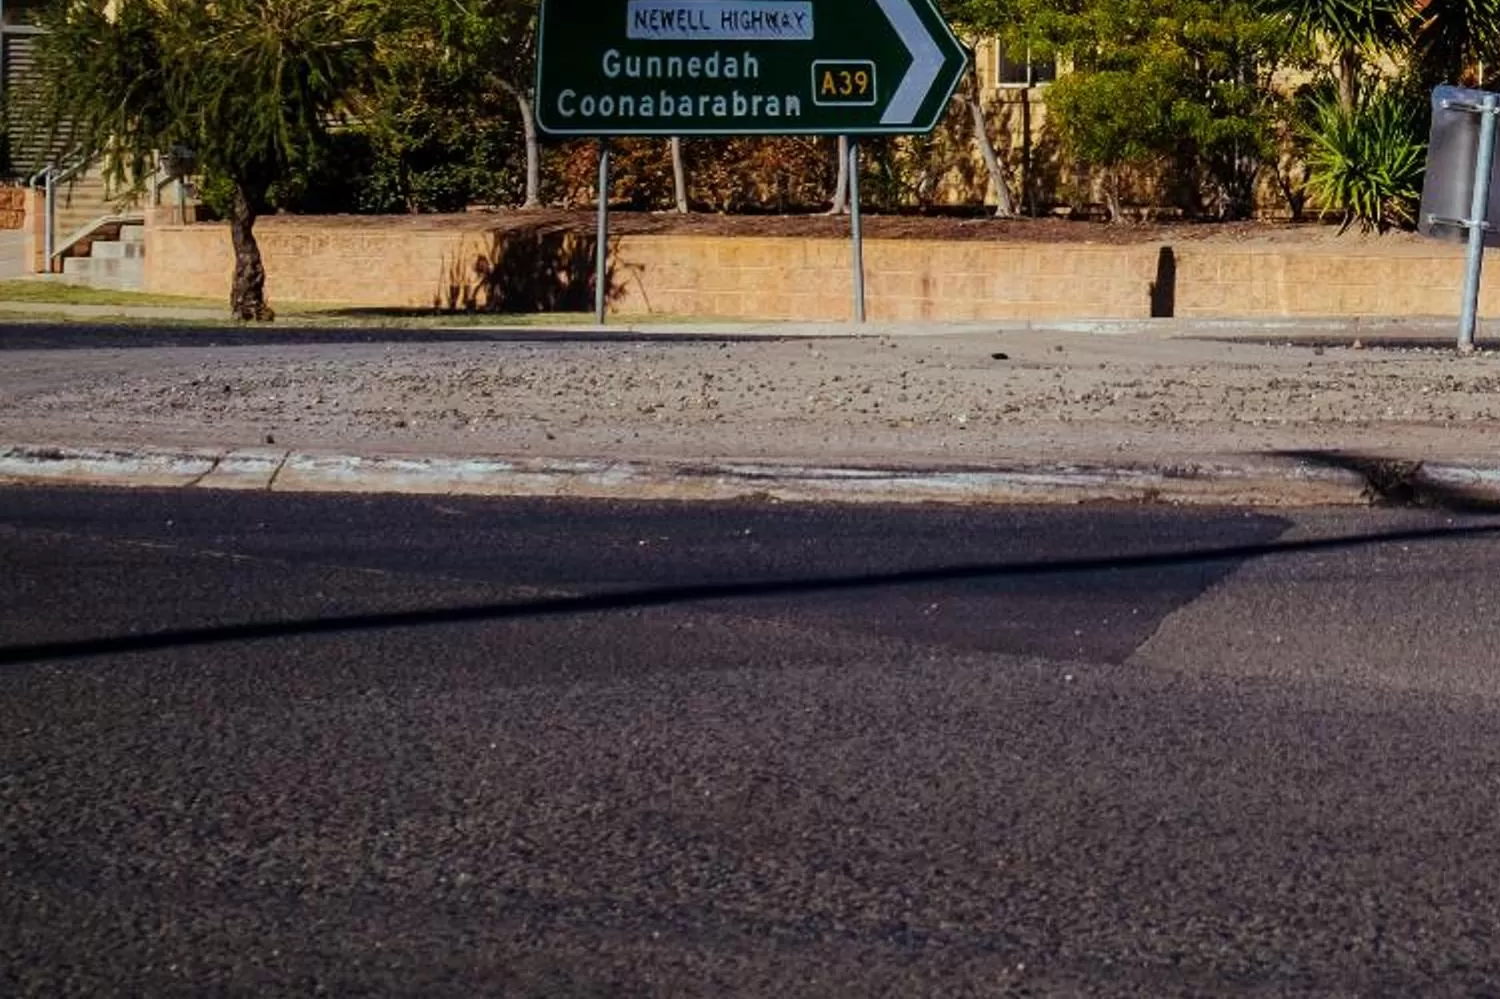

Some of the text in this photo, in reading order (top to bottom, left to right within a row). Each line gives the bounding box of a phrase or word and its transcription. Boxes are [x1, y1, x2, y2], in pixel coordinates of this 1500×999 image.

[633, 10, 806, 34] NEWELL HIGHWAY
[603, 49, 759, 79] Gunnedah
[820, 70, 870, 95] A39
[557, 89, 801, 118] Coonabarabran
